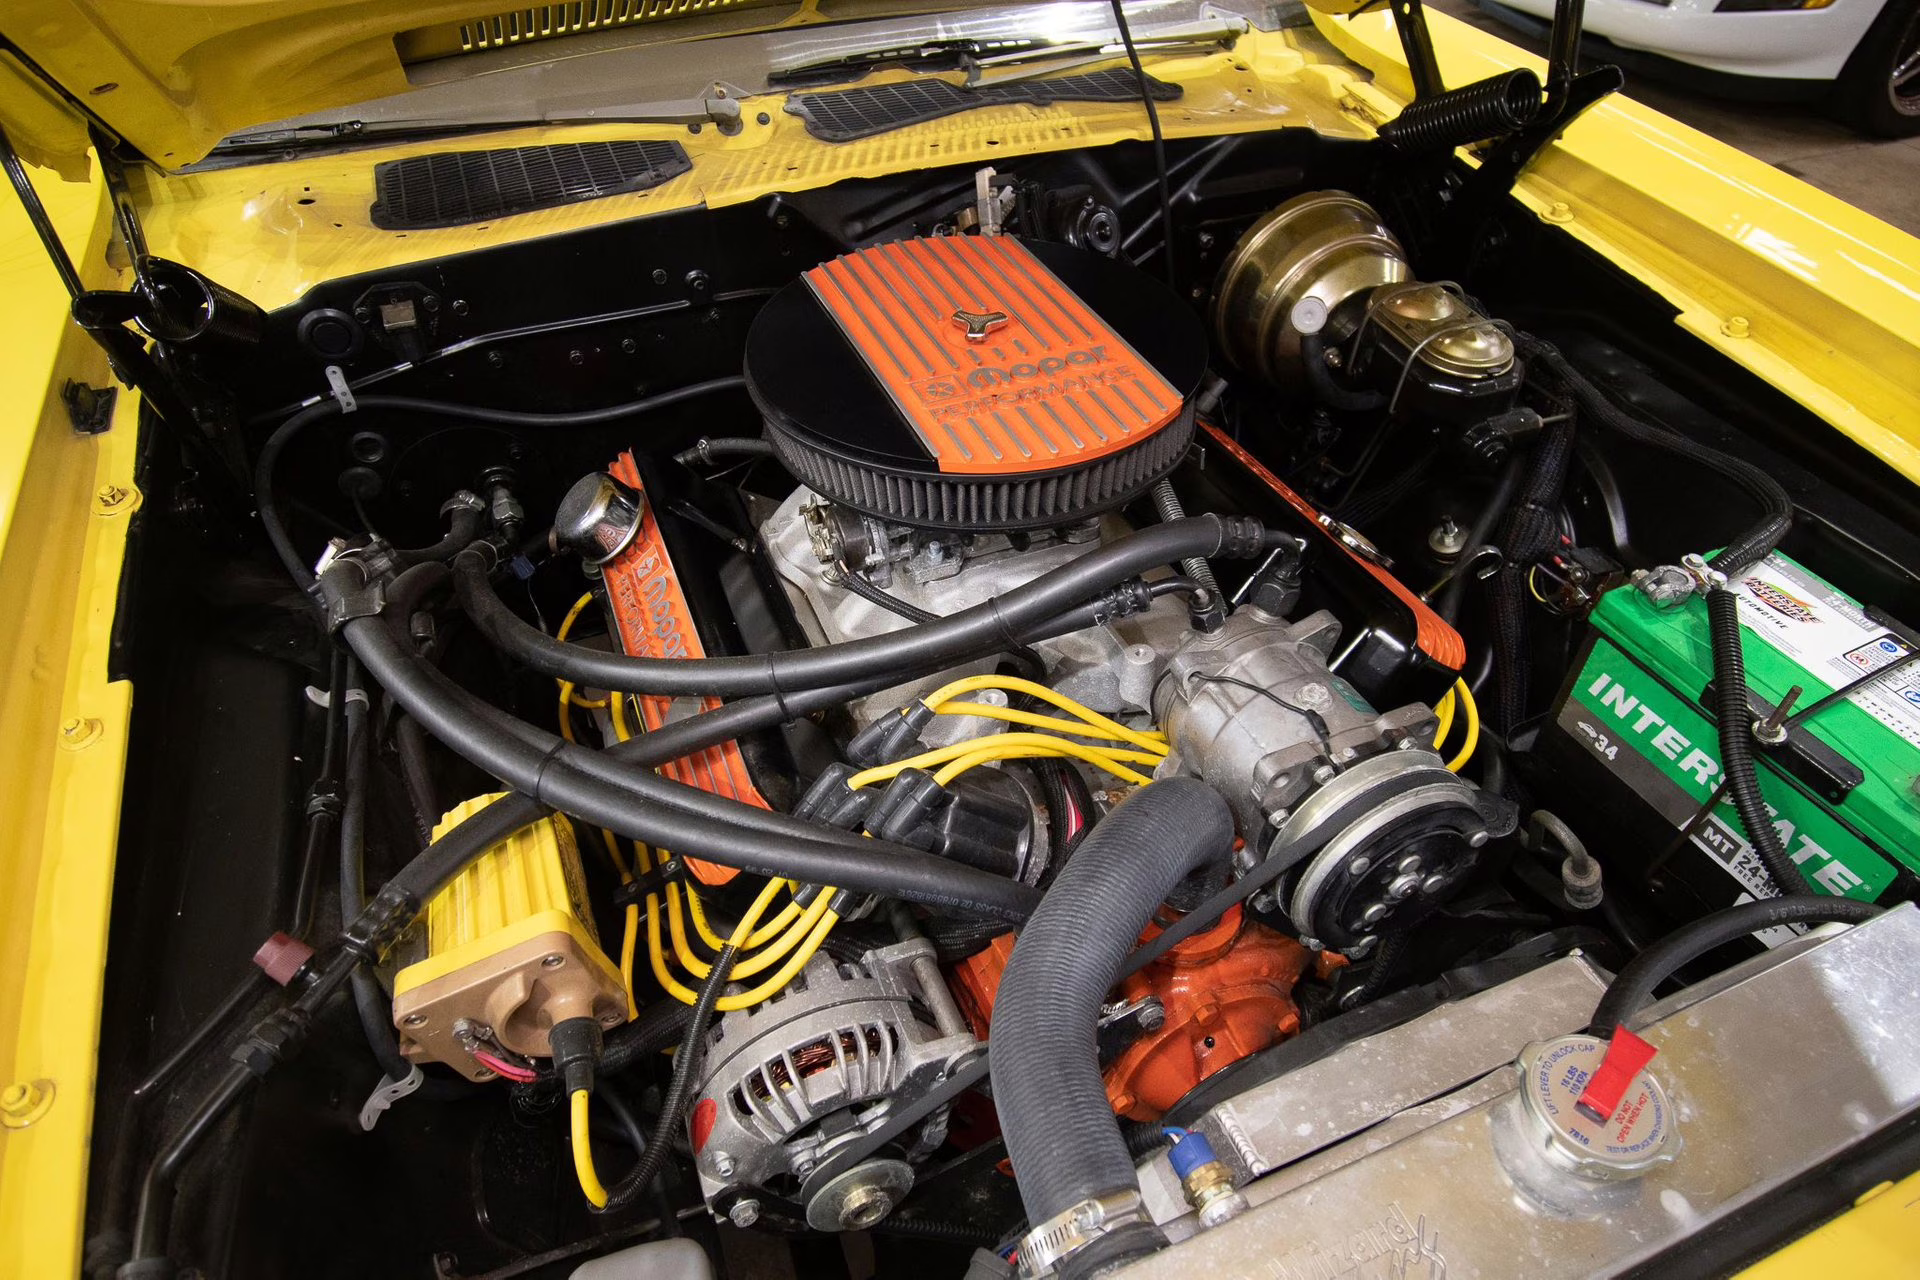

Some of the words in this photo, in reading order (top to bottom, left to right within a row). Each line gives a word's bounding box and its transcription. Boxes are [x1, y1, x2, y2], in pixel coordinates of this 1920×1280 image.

[930, 364, 1137, 421] PERFORMANCE
[1735, 593, 1790, 630] AUTOMOTIVE
[1745, 582, 1808, 624] BATTERIES
[1747, 577, 1822, 624] INTERSTATE
[1594, 734, 1619, 761] 34
[1587, 672, 1865, 897] INTERATE
[1703, 826, 1735, 854] MT
[1733, 865, 1753, 884] FREE
[1754, 883, 1771, 898] REP
[1548, 1044, 1577, 1063] UNLOCK
[1577, 1043, 1595, 1053] CAP
[1542, 1060, 1553, 1071] TO
[1566, 1065, 1579, 1081] LBS
[1540, 1071, 1551, 1096] LEVER
[1569, 1083, 1581, 1096] 110
[1576, 1070, 1589, 1086] KPA
[1543, 1097, 1559, 1115] LIFT
[1615, 1112, 1626, 1125] DO
[1621, 1100, 1633, 1115] NOT
[1617, 1124, 1631, 1143] OPEN
[1626, 1105, 1642, 1125] WHEN
[1636, 1092, 1649, 1108] HOT
